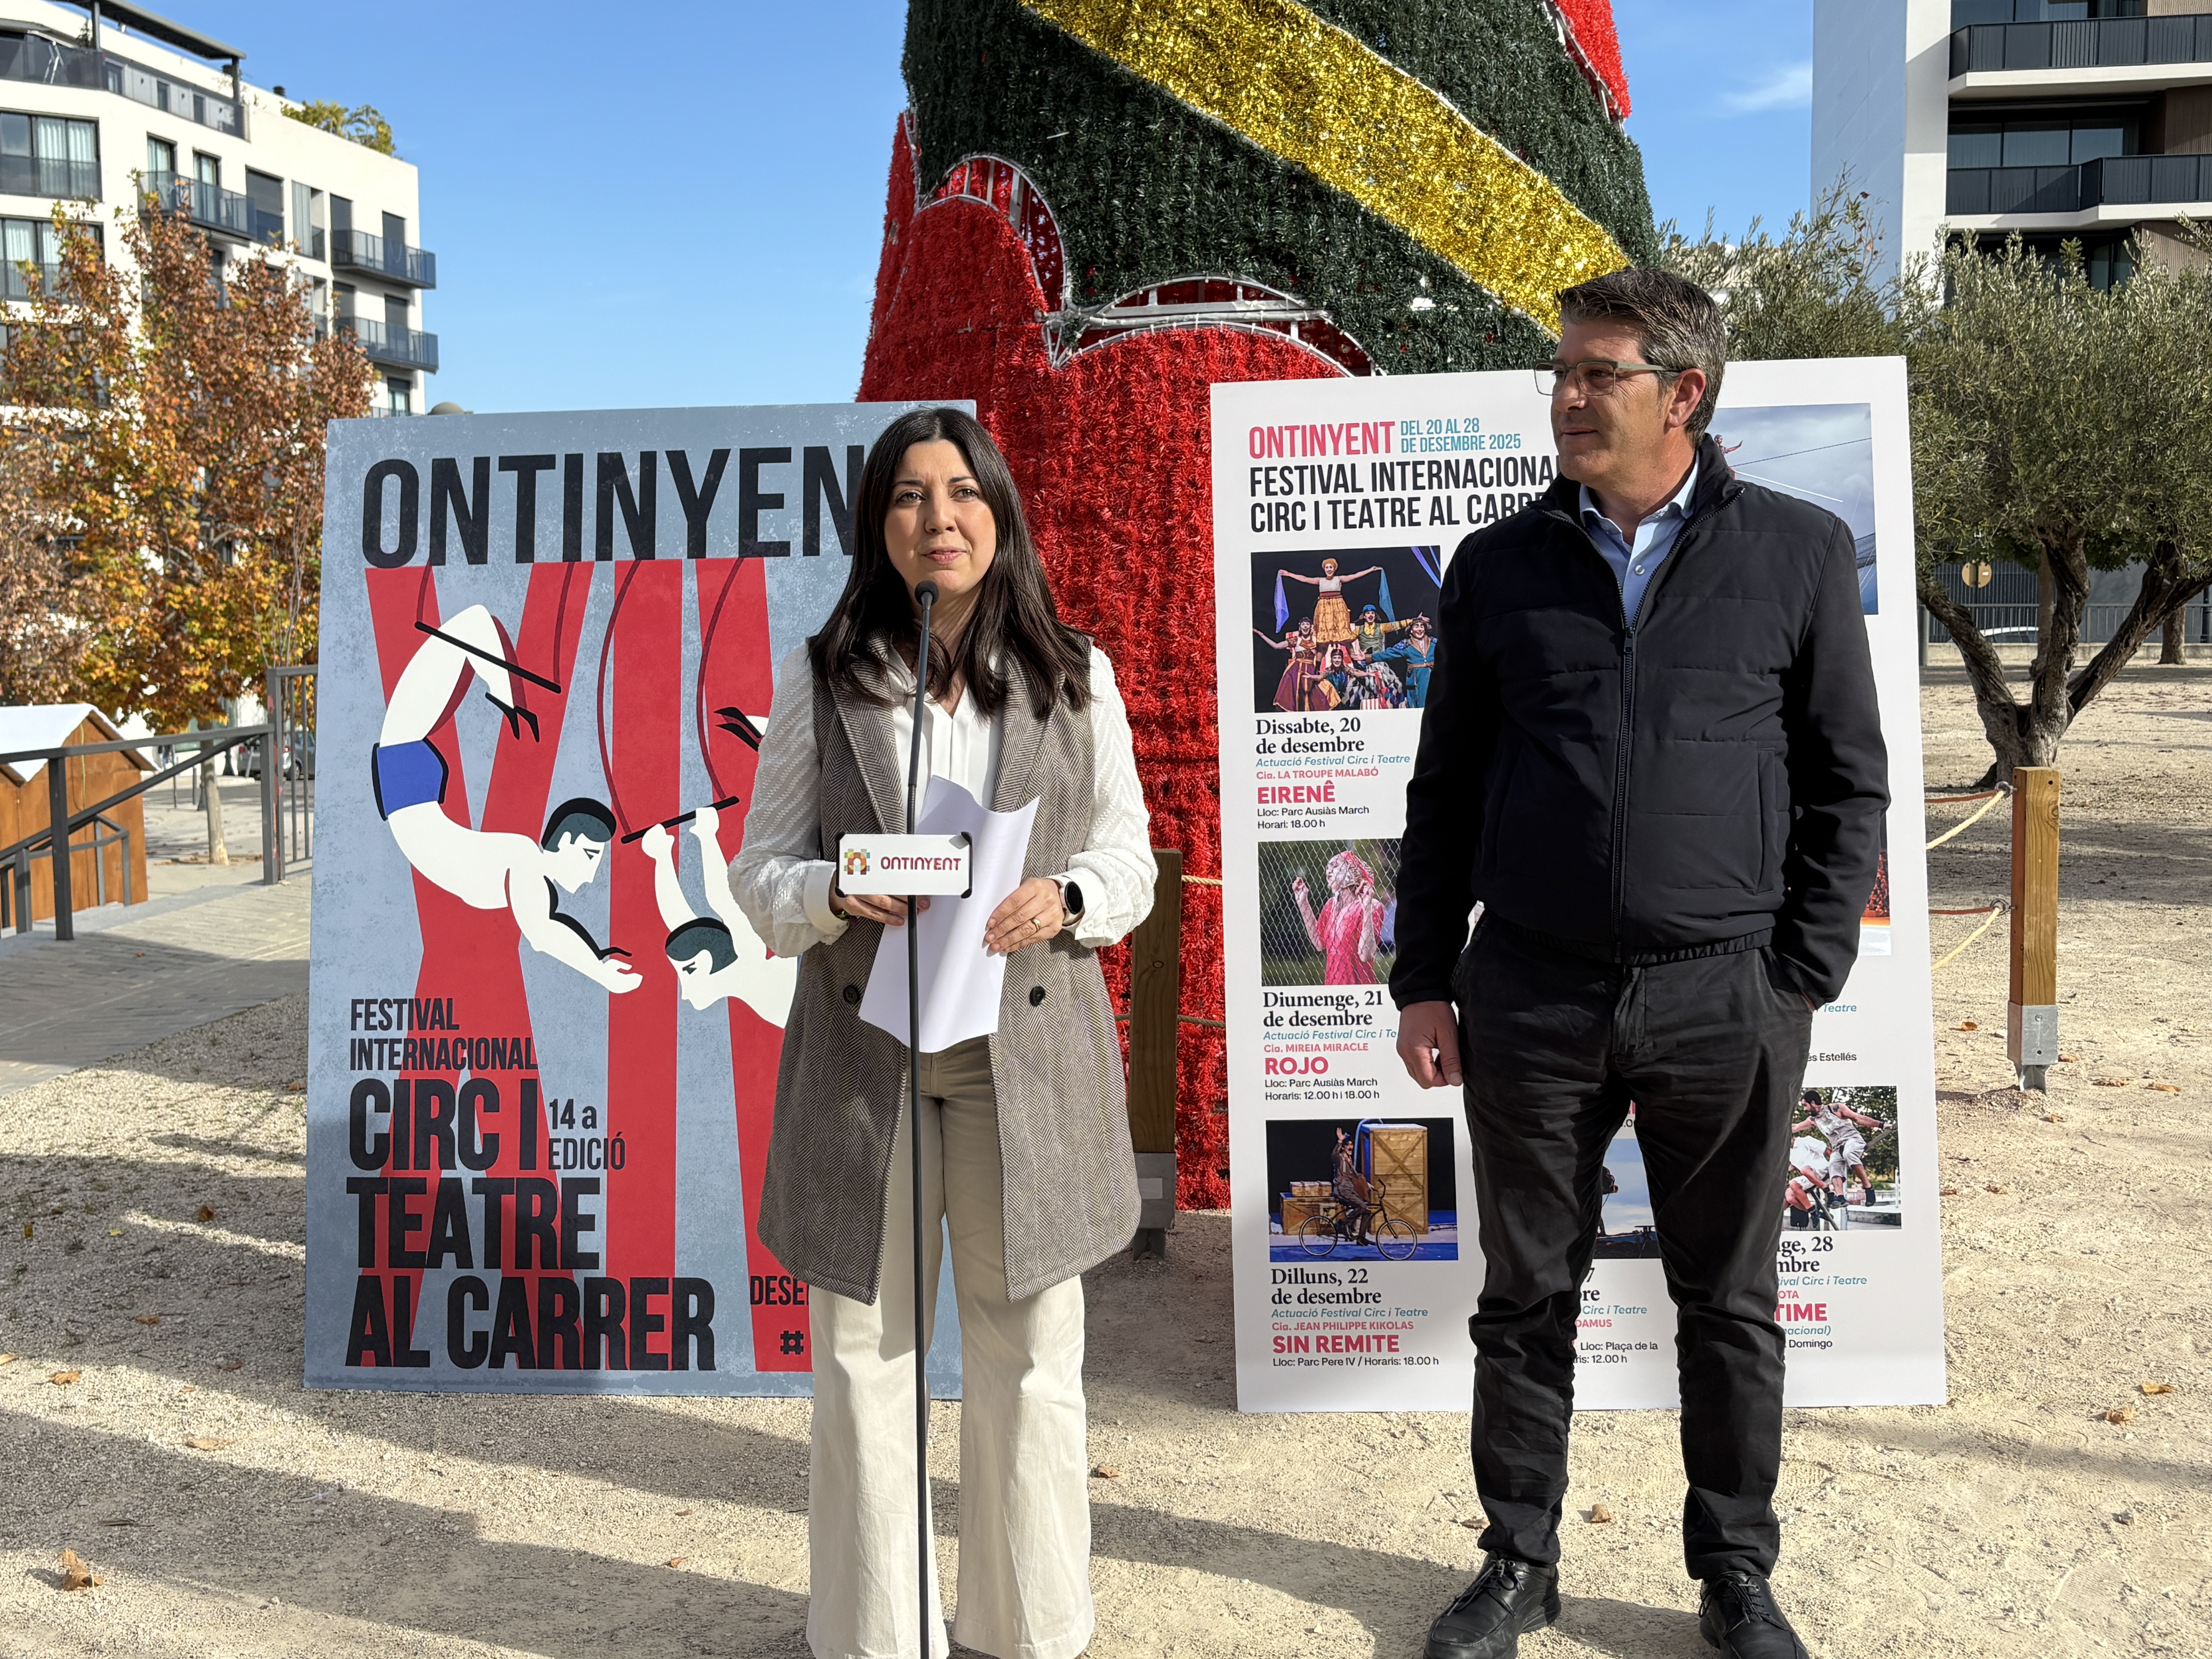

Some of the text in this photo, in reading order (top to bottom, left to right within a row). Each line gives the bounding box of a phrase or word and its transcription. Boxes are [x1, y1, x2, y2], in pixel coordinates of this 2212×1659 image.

[1401, 418, 1479, 436] DEL 20 AL 28
[1249, 421, 1395, 459] ONTINYENT
[1401, 434, 1520, 453] DE DESEMBRE 2025
[1250, 455, 1559, 497] FESTIVAL INTERNACIONA
[362, 445, 864, 568] ONTINYEN
[1251, 501, 1305, 532] CIRC
[1314, 501, 1320, 530] I
[1327, 497, 1421, 529] TEATRE
[1429, 496, 1460, 526] AL
[1256, 717, 1360, 735] Dissabte, 20
[1256, 736, 1364, 754] de desembre
[1256, 755, 1410, 767] Actuació Festival Circ i Teatre
[1293, 770, 1333, 778] TROUPE
[1335, 766, 1378, 777] MALABÓ
[1258, 780, 1335, 804] EIRENÊ
[1305, 807, 1336, 815] Ausiàs
[1339, 806, 1369, 814] March
[1258, 821, 1288, 829] Horari:
[1291, 820, 1317, 828] 18.00
[881, 857, 961, 870] ONTINYENT
[1263, 991, 1382, 1012] Diumenge, 21
[351, 998, 460, 1031] FESTIVAL
[1264, 1008, 1372, 1027] de desembre
[1263, 1030, 1309, 1040] Actuació
[1313, 1030, 1353, 1039] Festival
[1356, 1030, 1376, 1038] Circ
[350, 1037, 538, 1070] INTERNACIONAL
[1264, 1043, 1368, 1053] Cia. MIREIA MIRACLE
[1819, 1052, 1857, 1061] Estellés
[1266, 1056, 1328, 1075] ROJO
[1313, 1078, 1344, 1087] Ausiàs
[1266, 1092, 1301, 1100] Horaris:
[1304, 1091, 1330, 1099] 12.00
[1345, 1091, 1371, 1099] 18.00
[349, 1078, 597, 1171] CIRC I 14 a
[548, 1131, 626, 1170] EDICIÓ
[346, 1177, 600, 1269] TEATRE
[1812, 1236, 1833, 1252] 28
[1271, 1268, 1368, 1286] Dilluns, 22
[1802, 1276, 1824, 1285] Circ
[1827, 1276, 1830, 1285] i
[1833, 1276, 1867, 1285] Teatre
[750, 1276, 809, 1305] DESE
[1272, 1287, 1381, 1304] de desembre
[1271, 1308, 1428, 1317] Actuació Festival Circ i Teatre
[1582, 1305, 1647, 1314] Circ i Teatre
[345, 1275, 717, 1371] AL CARRER
[1272, 1321, 1413, 1331] Cia. JEAN PHILIPPE KIKOLAS
[1273, 1335, 1399, 1353] SIN REMITE
[1580, 1342, 1603, 1350] Lloc:
[1606, 1342, 1633, 1352] Plaça
[1635, 1342, 1647, 1350] de
[1649, 1342, 1658, 1350] la
[1789, 1340, 1832, 1350] Domingo
[1298, 1358, 1319, 1366] Parc
[1346, 1357, 1355, 1365] IV
[1358, 1356, 1362, 1366] /
[1365, 1357, 1401, 1365] Horaris:
[1403, 1357, 1431, 1365] 18.00
[1592, 1355, 1619, 1363] 12.00
[1621, 1355, 1627, 1363] h
